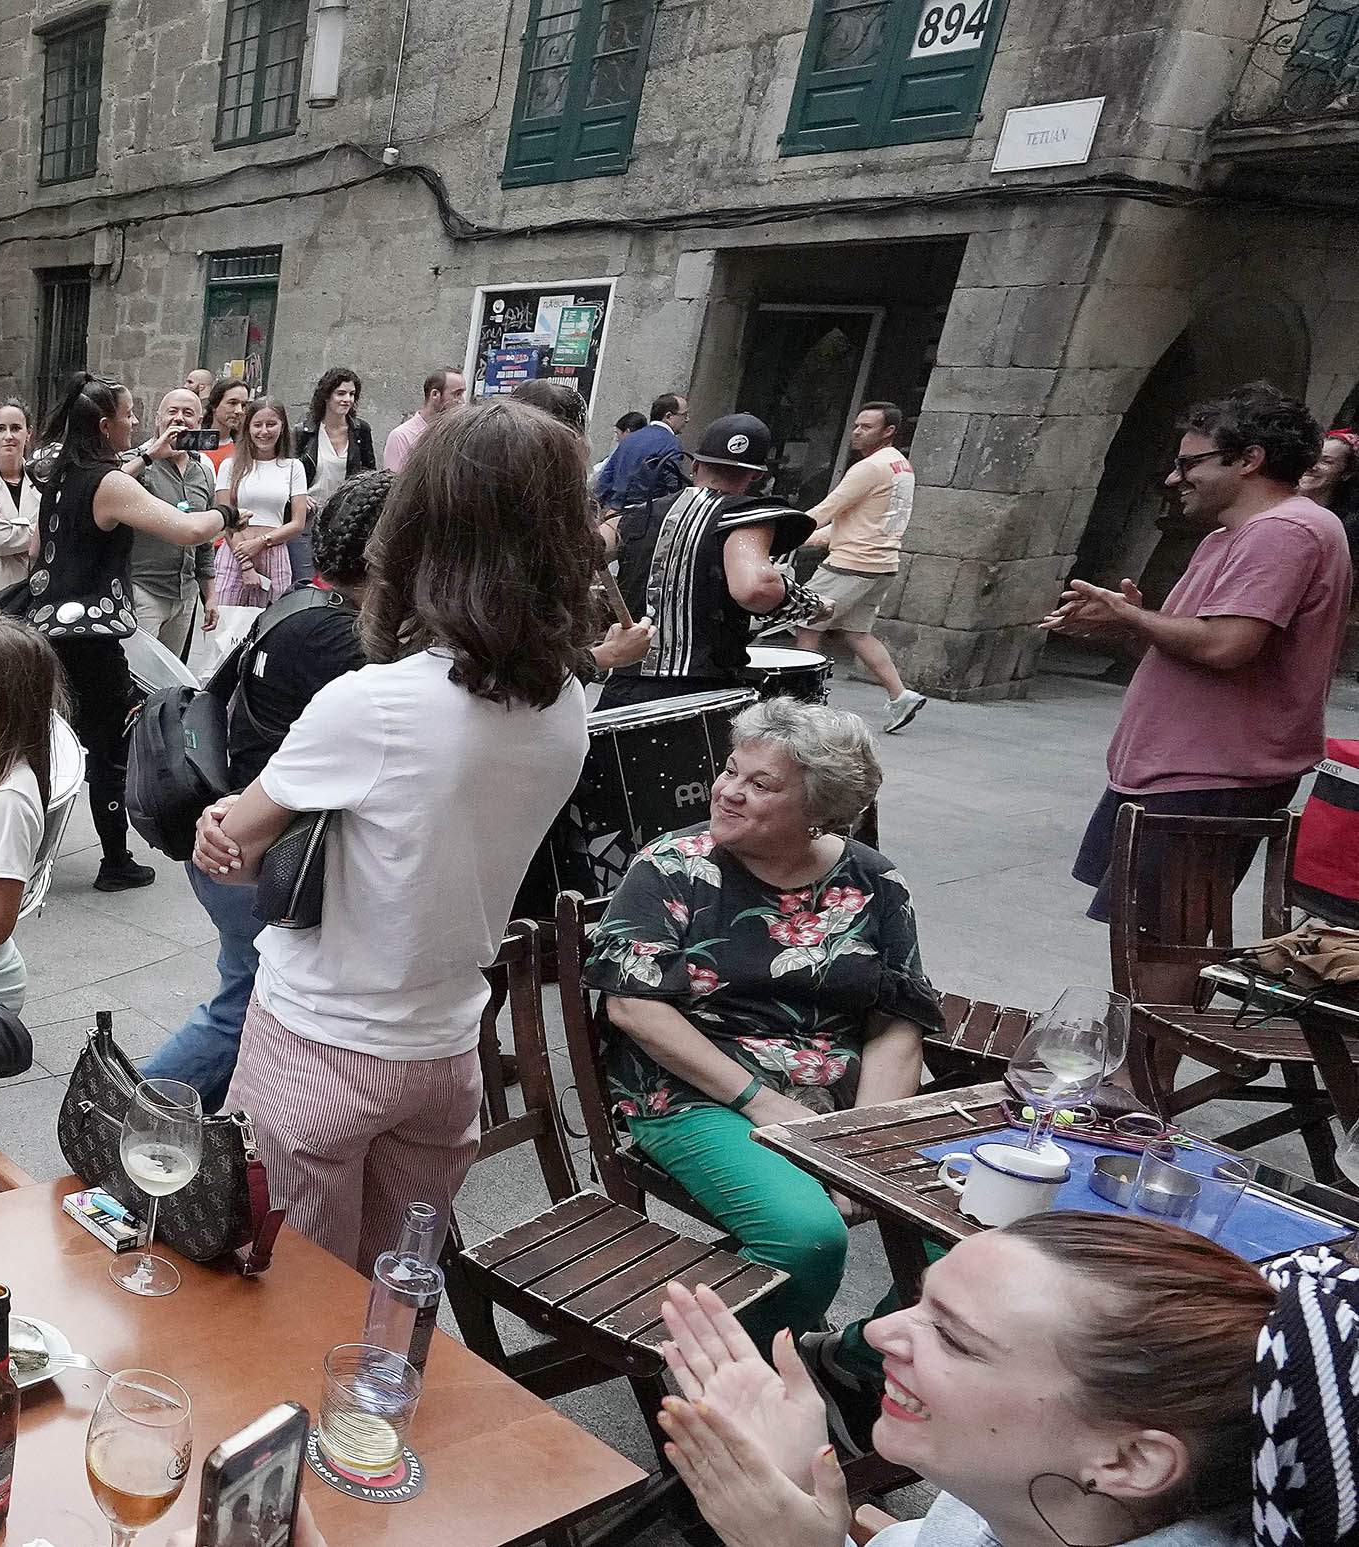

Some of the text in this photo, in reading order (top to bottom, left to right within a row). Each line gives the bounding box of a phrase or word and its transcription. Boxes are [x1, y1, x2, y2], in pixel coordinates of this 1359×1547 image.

[918, 0, 987, 48] 894
[307, 1435, 340, 1483] DESDE 1906
[361, 1485, 411, 1499] GALICIA
